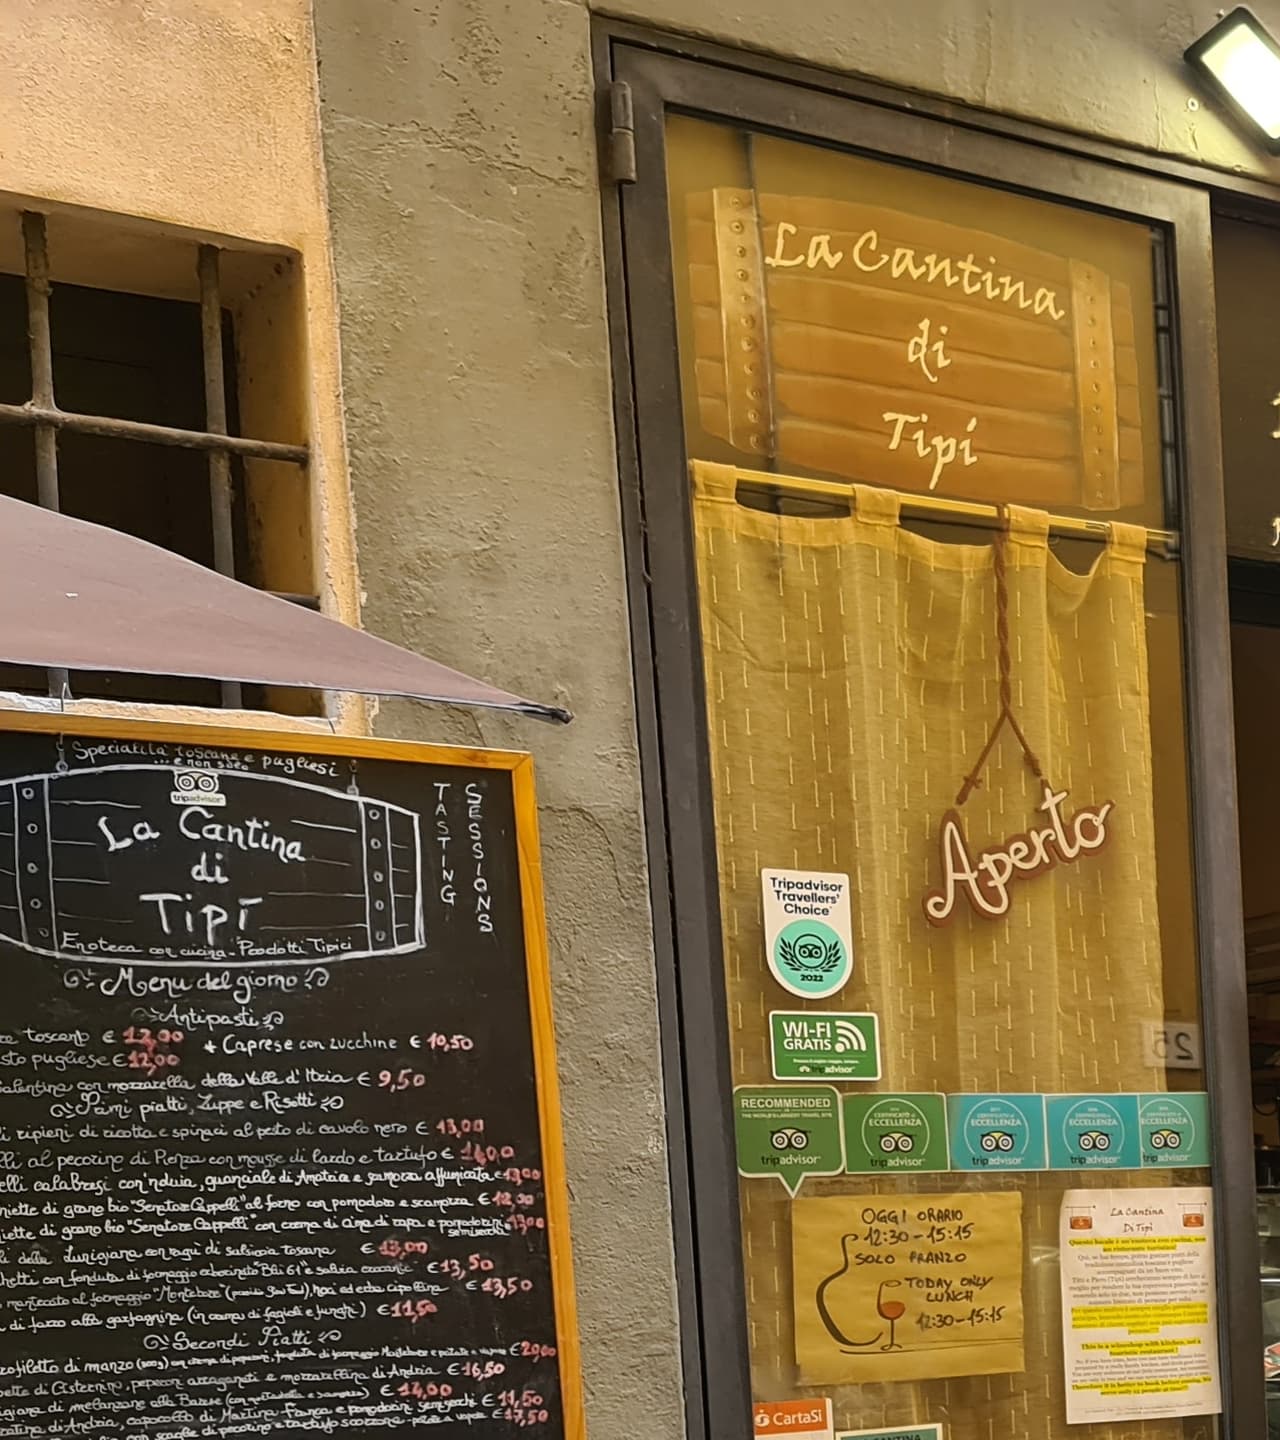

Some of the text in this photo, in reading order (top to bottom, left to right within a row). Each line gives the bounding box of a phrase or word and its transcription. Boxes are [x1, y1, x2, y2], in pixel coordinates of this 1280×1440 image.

[765, 222, 1067, 320] La Cantina
[907, 318, 951, 383] di
[175, 746, 239, 761] toscane
[244, 754, 255, 763] e
[261, 755, 340, 777] pugliesi
[187, 758, 211, 769] non
[98, 807, 306, 863] La Cantina
[433, 783, 457, 906] TASTING
[926, 787, 1113, 918] Aperto
[465, 783, 493, 932] SESSIONS
[192, 853, 229, 884] di
[770, 876, 843, 893] Tripadvisor
[774, 889, 840, 905] Travellers'
[784, 903, 830, 916] Choice
[60, 932, 352, 961] Enoteca con cucina Prodotti Tipici
[101, 967, 298, 1004] Menu del giorno
[800, 974, 824, 983] 2022
[159, 1005, 259, 1031] Antipasti
[782, 1020, 831, 1038] WI-FI
[222, 1034, 293, 1055] Caprese
[300, 1041, 324, 1050] con
[330, 1032, 398, 1050] zucchine
[783, 1038, 831, 1051] GRATIS
[32, 1050, 110, 1071] pugliese
[812, 1066, 855, 1075] tripadvisor
[77, 1082, 102, 1093] con
[201, 1070, 246, 1087] della
[377, 1069, 426, 1092] 9,50
[198, 1093, 245, 1114] Zuppe
[262, 1091, 316, 1114] Risotti
[741, 1098, 831, 1109] RECOMMENDED
[16, 1124, 73, 1144] ripieni
[79, 1124, 98, 1138] di
[103, 1126, 158, 1139] ricotta
[172, 1124, 228, 1141] spinaci
[233, 1122, 254, 1138] al
[296, 1118, 314, 1135] di
[318, 1119, 369, 1135] cavolo
[374, 1122, 408, 1138] nero
[869, 1118, 922, 1127] ECCELLENZA
[971, 1118, 1022, 1127] ECCELLENZA
[1069, 1118, 1118, 1127] ECCELLENZA
[57, 1146, 437, 1172] pecorino di lardo tartufo
[761, 1153, 821, 1165] tripadvisor
[871, 1156, 925, 1167] tripadvisor
[972, 1156, 1024, 1166] tripadvisor
[1070, 1155, 1120, 1165] tripadvisor
[1143, 1153, 1190, 1163] tripadvisor
[107, 1197, 130, 1213] bio
[1110, 1206, 1164, 1216] La Cantina
[861, 1207, 963, 1224] OGGI ORARIO
[1124, 1223, 1134, 1233] Di
[855, 1251, 967, 1265] SOLO PRANZO
[905, 1275, 994, 1292] TODAY ONLY
[926, 1290, 973, 1303] LUNCH
[172, 1325, 312, 1350] Secondi Piatti
[462, 1361, 505, 1381] 16,50
[773, 1409, 822, 1426] CartaSi
